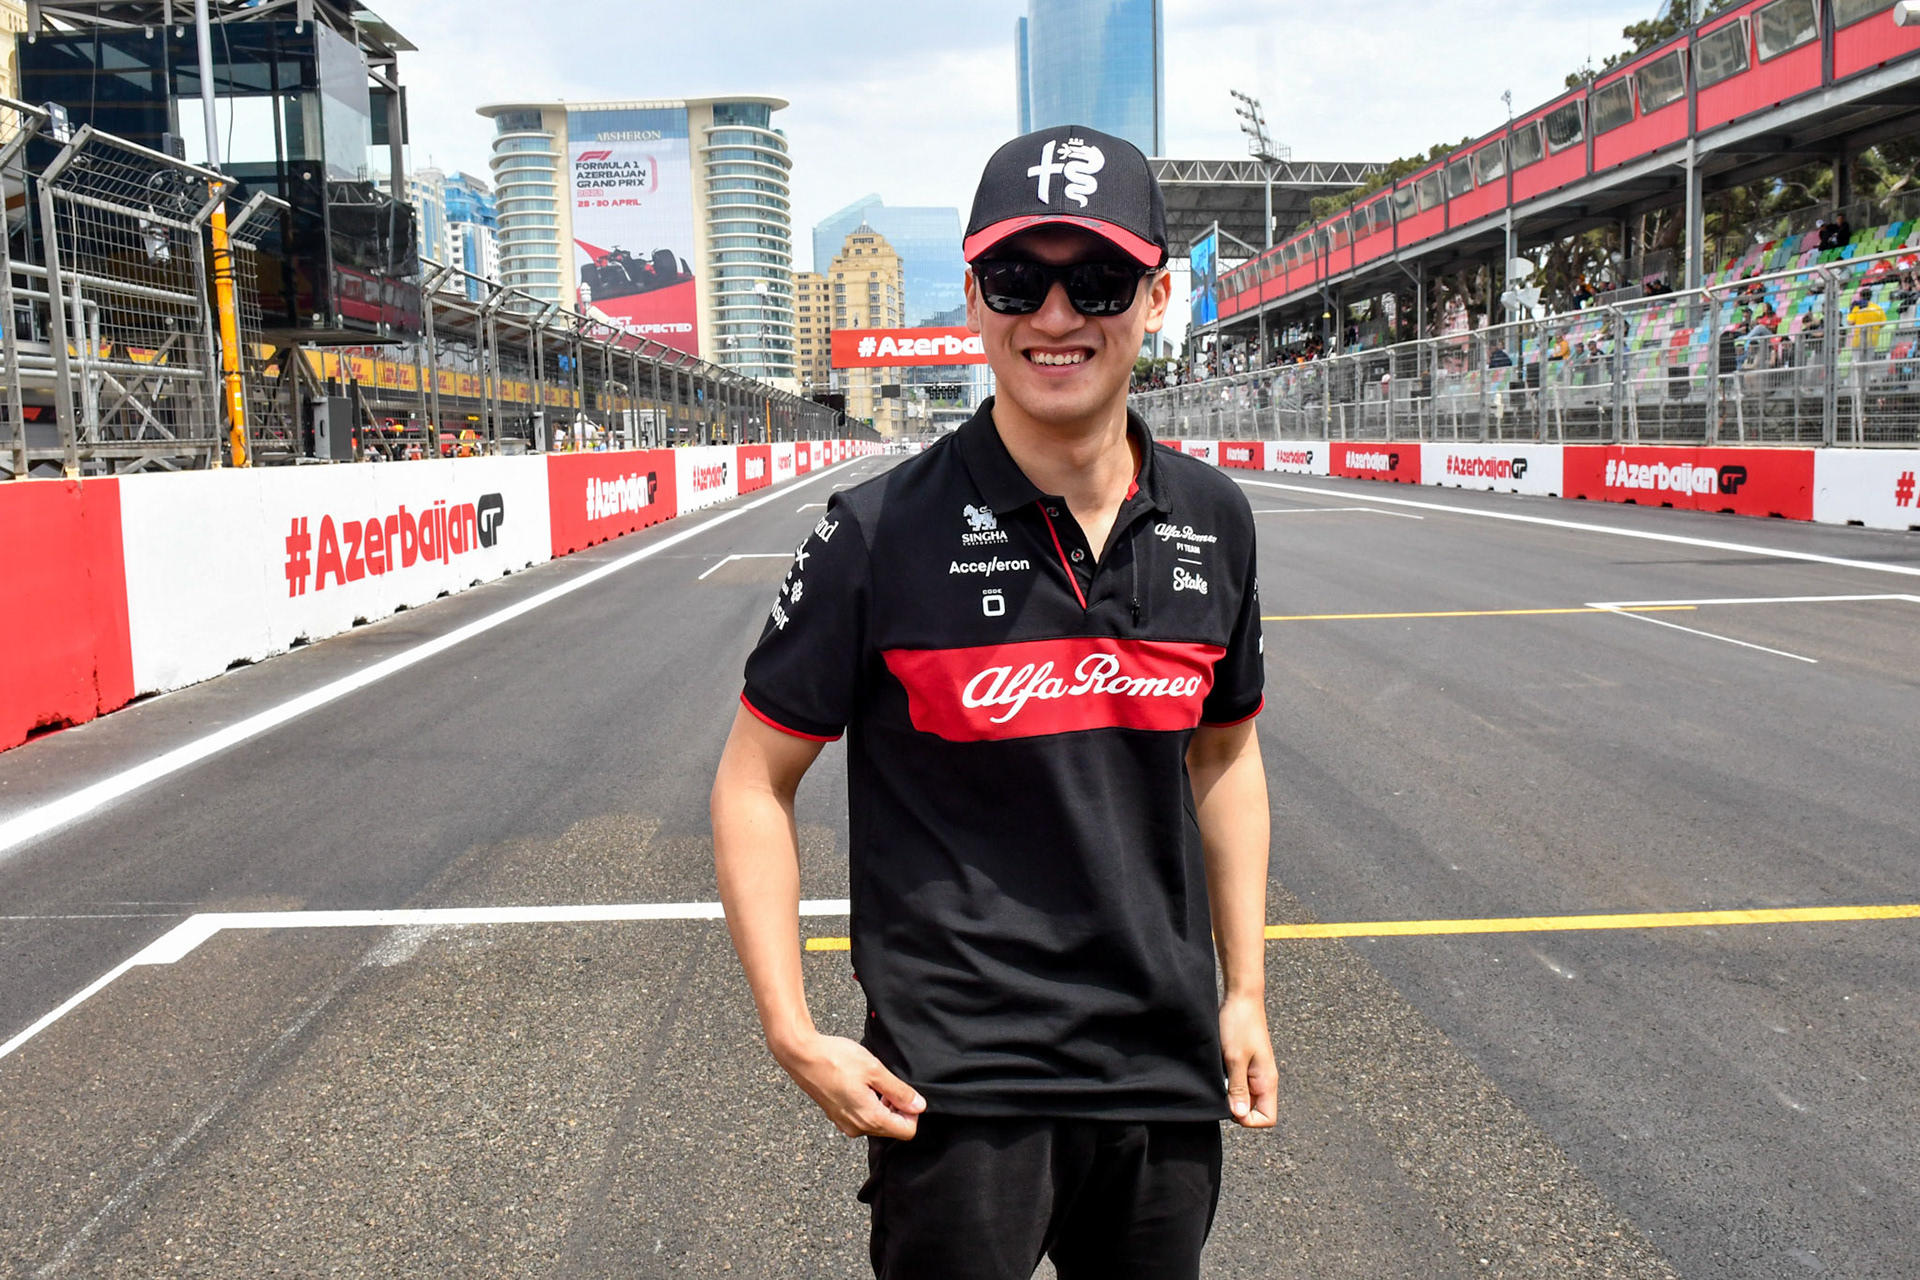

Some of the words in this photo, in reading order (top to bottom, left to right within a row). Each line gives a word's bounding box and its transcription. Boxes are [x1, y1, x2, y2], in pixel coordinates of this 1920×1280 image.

[597, 130, 661, 141] ABSHERON
[576, 161, 631, 170] FORMULA
[633, 161, 640, 169] 1
[577, 170, 646, 179] AZERBAIJAN
[577, 180, 616, 188] GRAND
[618, 179, 645, 187] PRIX
[612, 199, 642, 207] APRIL
[1605, 460, 1747, 496] #AzerbaijanGP
[961, 531, 1008, 543] SINGHA
[1154, 523, 1182, 541] Alfa
[285, 493, 504, 598] #AzerbaijanGP
[1173, 567, 1208, 594] Stake
[962, 660, 1068, 723] Alfa
[1068, 653, 1202, 697] Romeo
